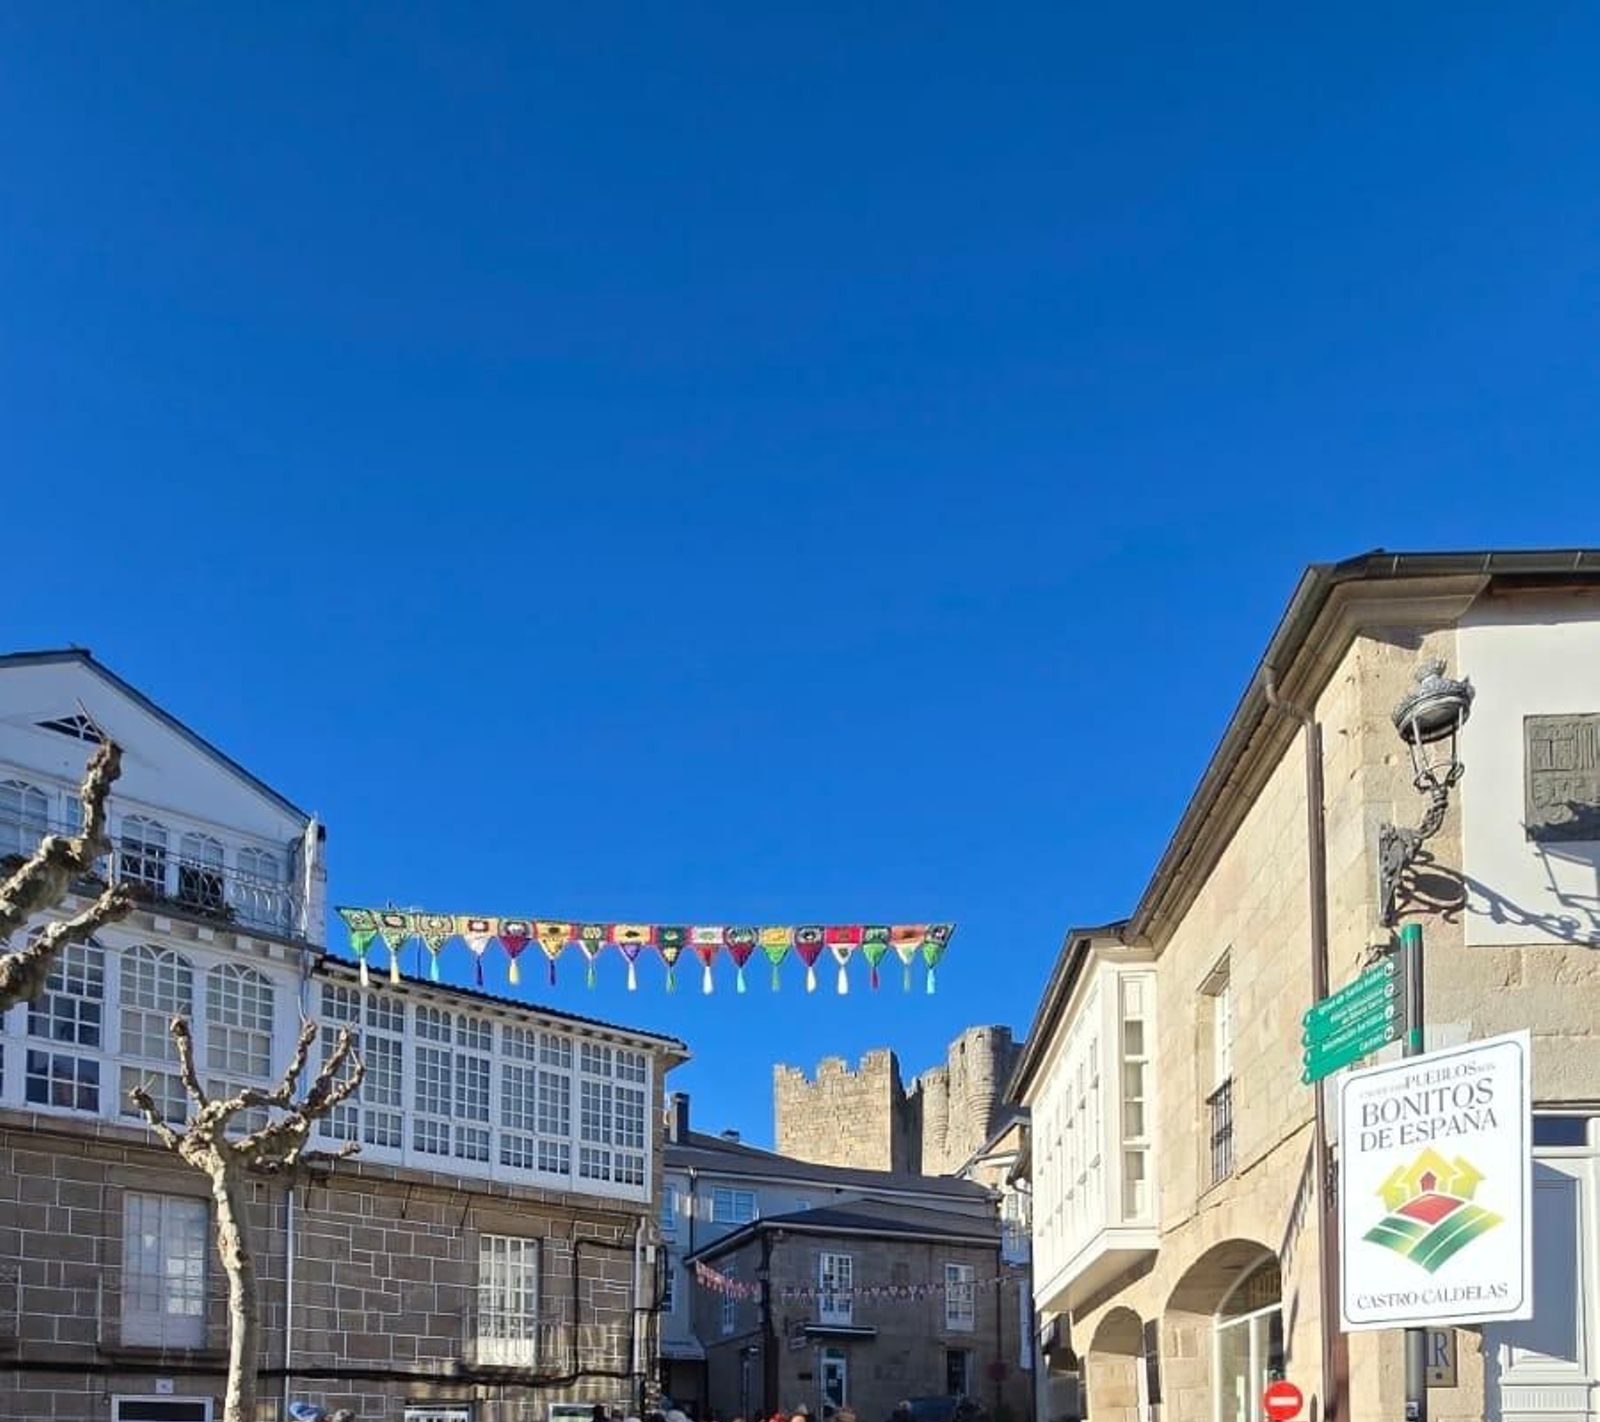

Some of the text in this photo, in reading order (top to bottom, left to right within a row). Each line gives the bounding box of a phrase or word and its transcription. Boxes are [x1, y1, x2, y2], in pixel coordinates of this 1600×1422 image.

[1405, 1063, 1476, 1088] PUEBLOS
[1362, 1078, 1494, 1128] BONITOS
[1360, 1106, 1497, 1152] DE ESPAÑA
[1357, 1282, 1508, 1310] CASTRO CALDELAS
